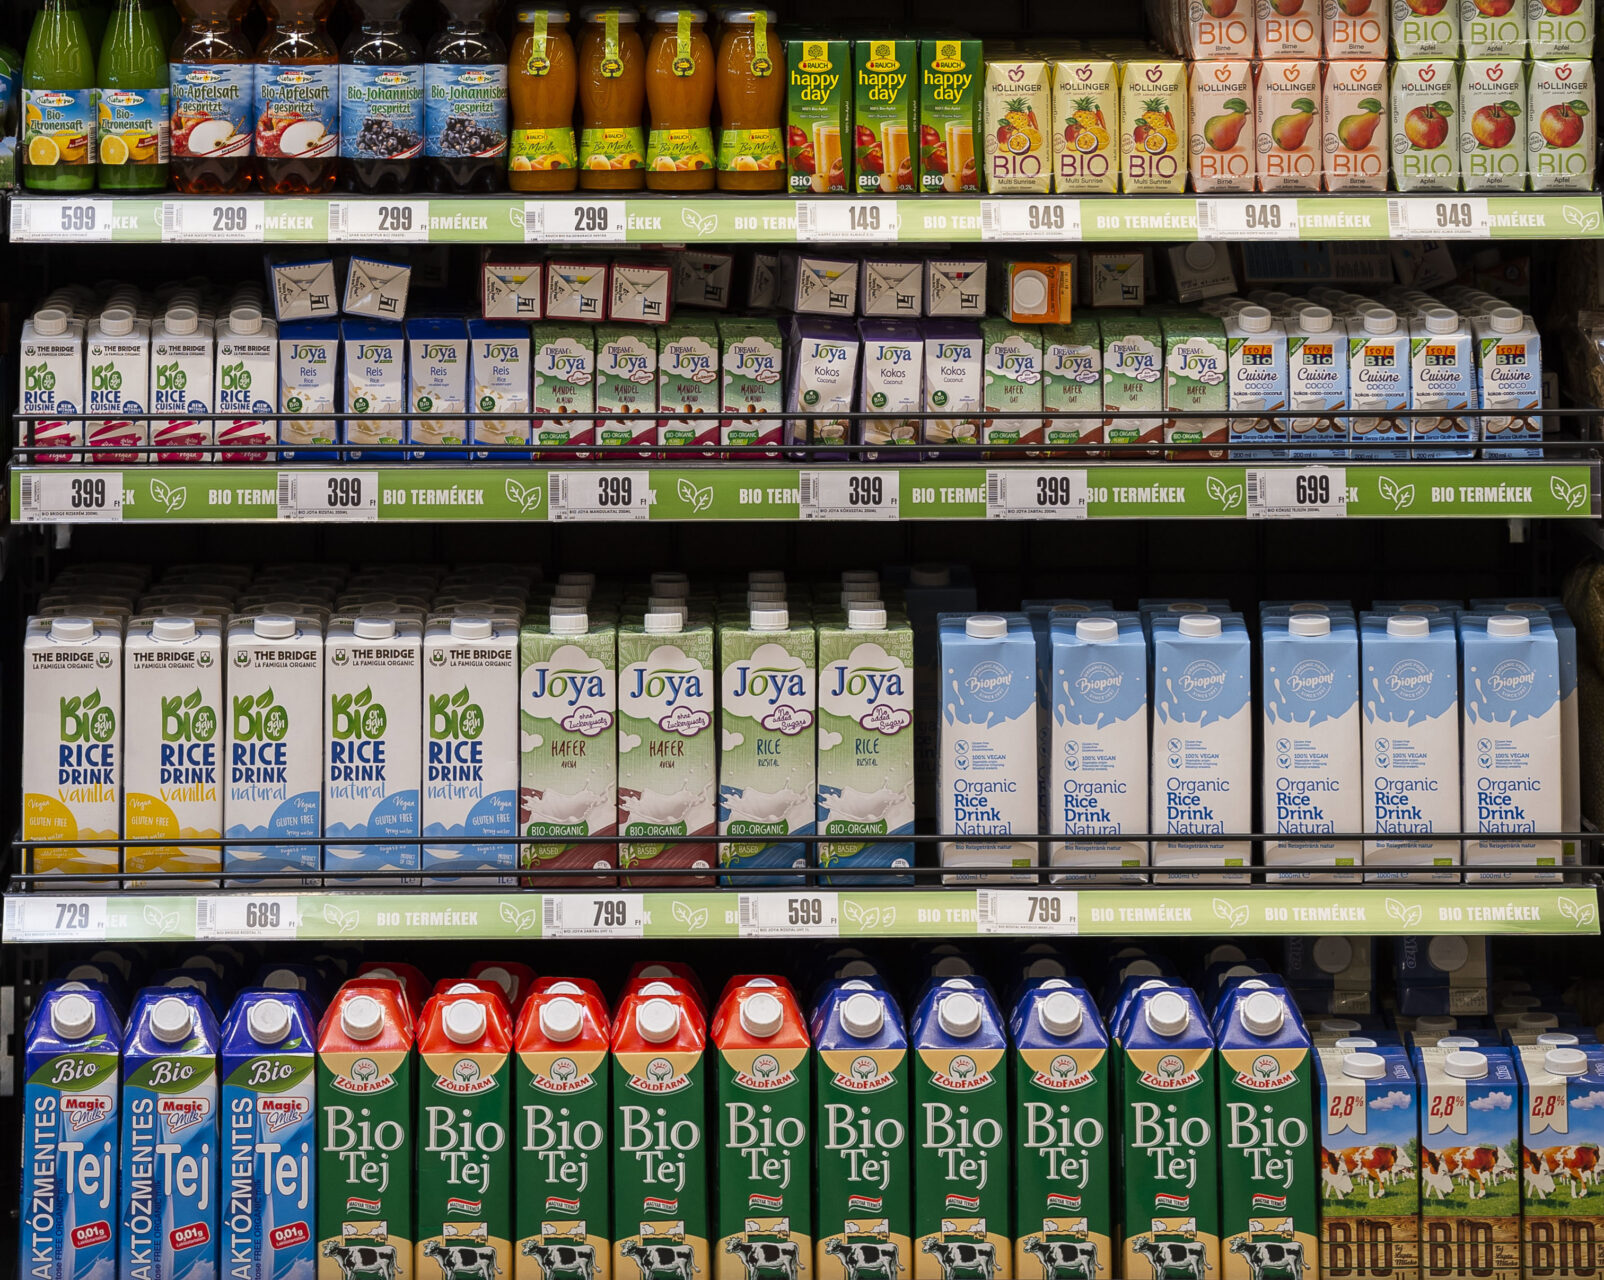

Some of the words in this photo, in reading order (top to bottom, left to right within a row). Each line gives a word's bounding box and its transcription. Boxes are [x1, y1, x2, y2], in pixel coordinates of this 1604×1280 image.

[791, 73, 839, 90] happy
[173, 84, 239, 100] Bio-Apfelsaft
[801, 86, 830, 104] day
[46, 110, 64, 119] Bio-
[182, 101, 222, 113] gespritzt
[30, 119, 83, 132] Zitronensaft
[995, 155, 1041, 177] BIO
[61, 207, 95, 230] 599
[574, 207, 608, 230] 299
[849, 206, 880, 230] 149
[1028, 206, 1064, 229] 949
[291, 343, 326, 362] Joya
[300, 367, 316, 376] Reis
[815, 367, 839, 377] Kokos
[1237, 368, 1278, 383] Cuisine
[25, 391, 54, 403] RICE
[72, 478, 105, 508] 399
[384, 489, 405, 505] BIO
[411, 486, 484, 505] TERMÉKEK
[1037, 477, 1069, 505] 399
[1297, 475, 1329, 503] 699
[33, 652, 52, 662] THE
[56, 652, 94, 663] BRIDGE
[532, 668, 605, 706] Joya
[59, 744, 114, 767] RICE
[551, 740, 586, 756] HAFER
[757, 738, 780, 755] RICE
[59, 767, 114, 784] DRINK
[58, 783, 115, 803] vanilla
[232, 783, 286, 801] natural
[1478, 778, 1541, 797] Organic
[1478, 792, 1511, 807] Rice
[276, 816, 298, 827] GLUTEN
[300, 815, 314, 825] FREE
[1478, 807, 1524, 821] Drink
[532, 825, 584, 835] BIO-ORGANIC
[56, 903, 89, 929] 729
[246, 902, 280, 928] 689
[788, 898, 822, 925] 599
[1028, 896, 1061, 923] 799
[1092, 907, 1113, 920] BIO
[1118, 904, 1192, 921] TERMÉKEK
[54, 1060, 99, 1082] Bio
[336, 1075, 391, 1092] ZÖLDFARM
[66, 1099, 105, 1111] Magic
[1330, 1095, 1363, 1118] 2,8%
[324, 1106, 404, 1152] Bio
[725, 1103, 805, 1149] Bio
[1227, 1103, 1307, 1148] Bio
[59, 1142, 111, 1208] Tej
[339, 1152, 389, 1194] Tej
[742, 1148, 791, 1189] Tej
[1243, 1148, 1293, 1189] Tej
[1329, 1222, 1393, 1277] BIO
[1429, 1222, 1493, 1277] BIO
